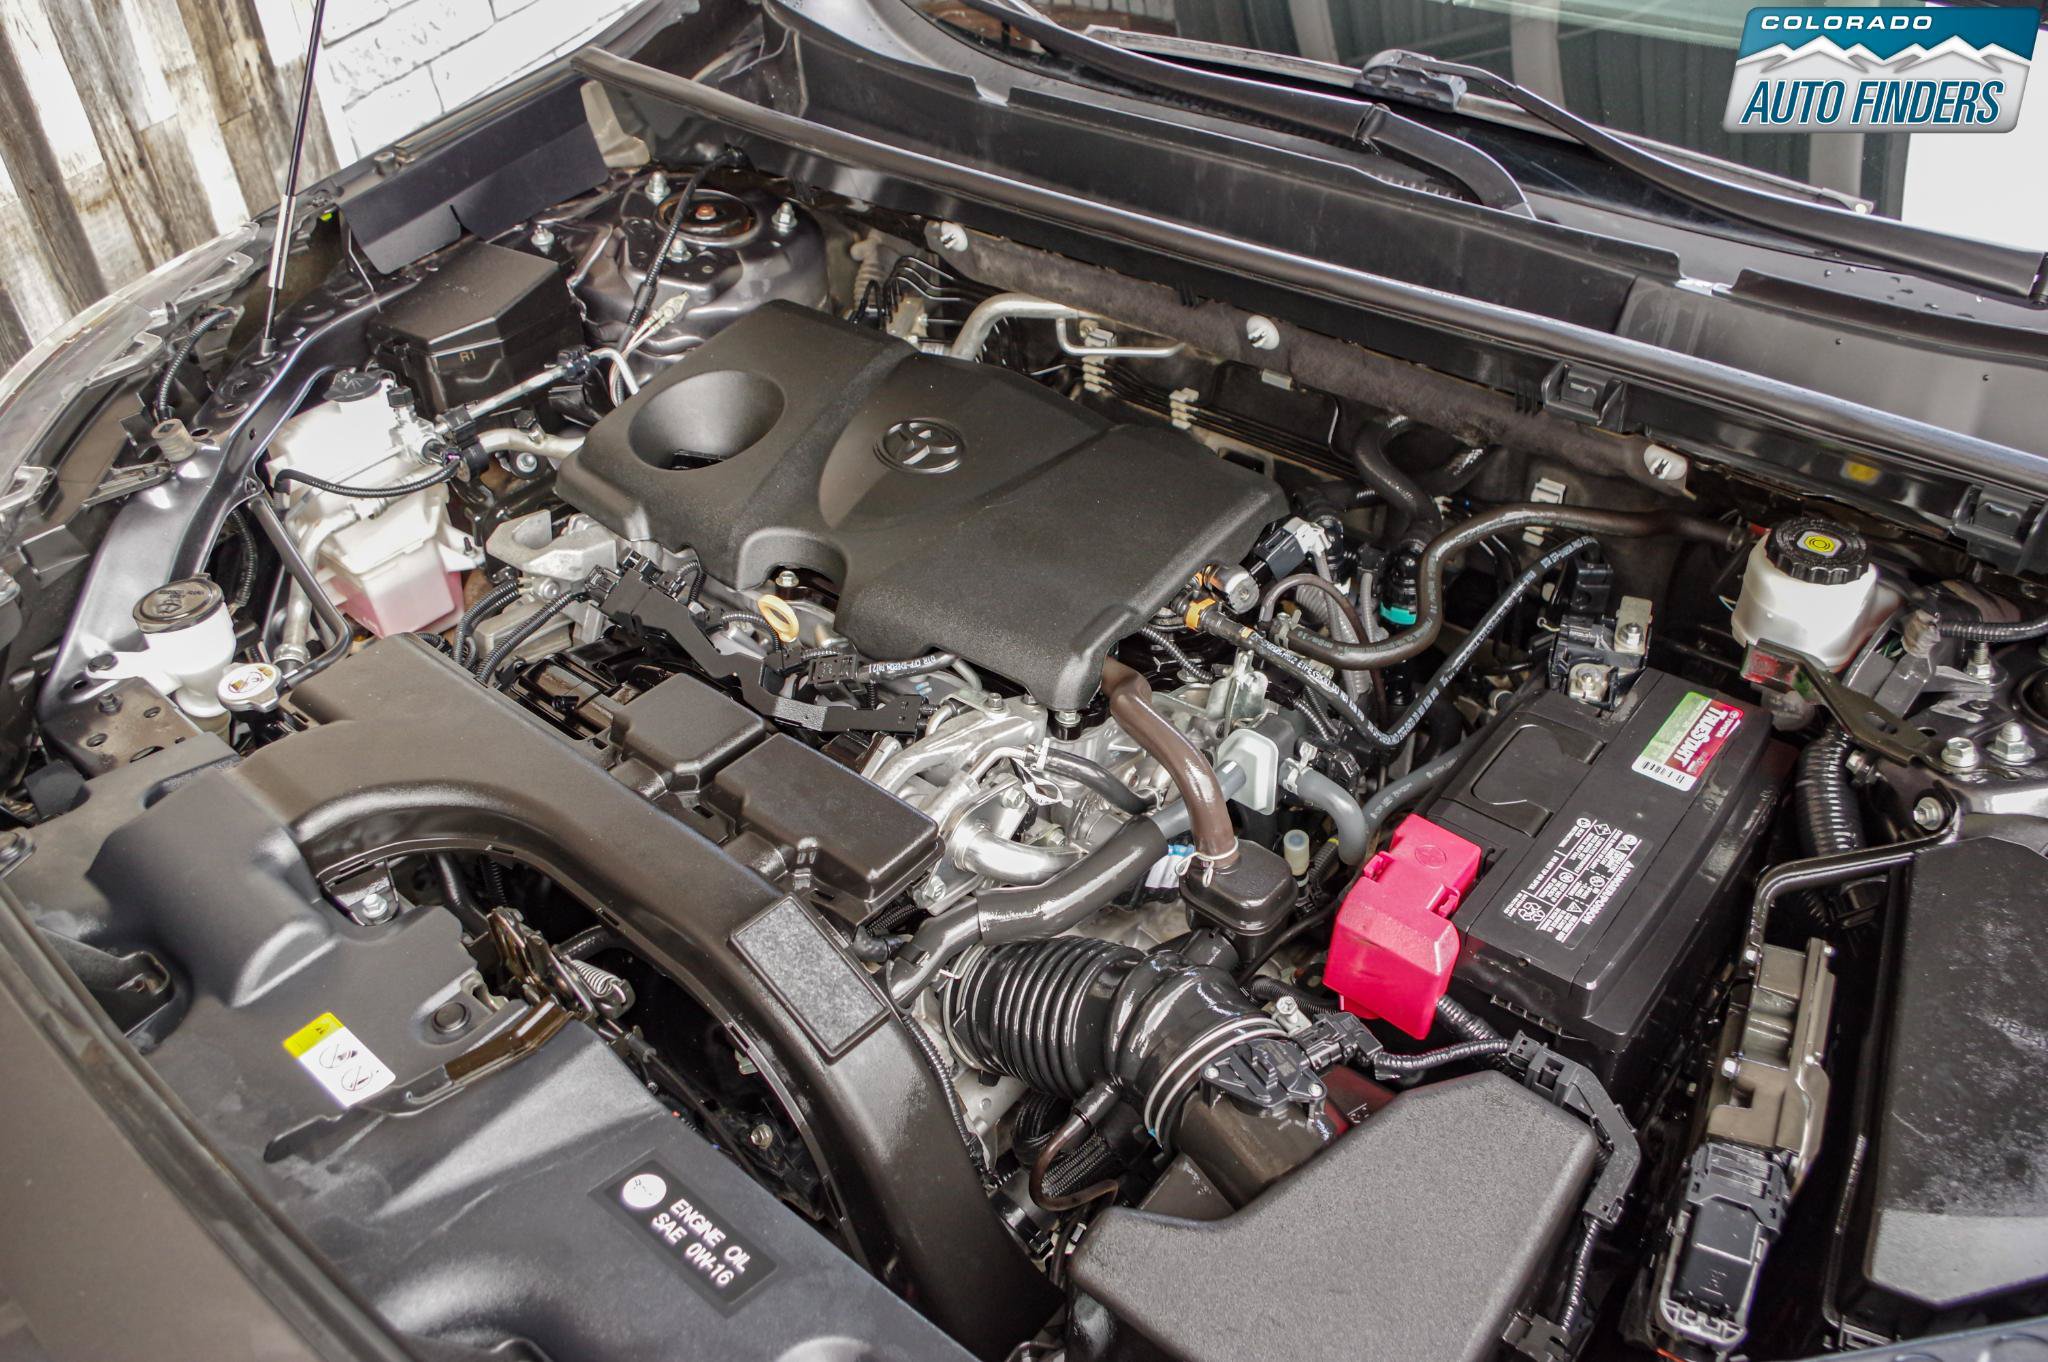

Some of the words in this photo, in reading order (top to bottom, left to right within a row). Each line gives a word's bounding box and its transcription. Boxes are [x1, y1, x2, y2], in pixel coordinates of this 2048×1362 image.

[651, 1213, 687, 1244] SAE
[685, 1242, 734, 1286] 0W-16
[670, 1198, 726, 1246] ENGINE
[724, 1245, 750, 1272] OIL
